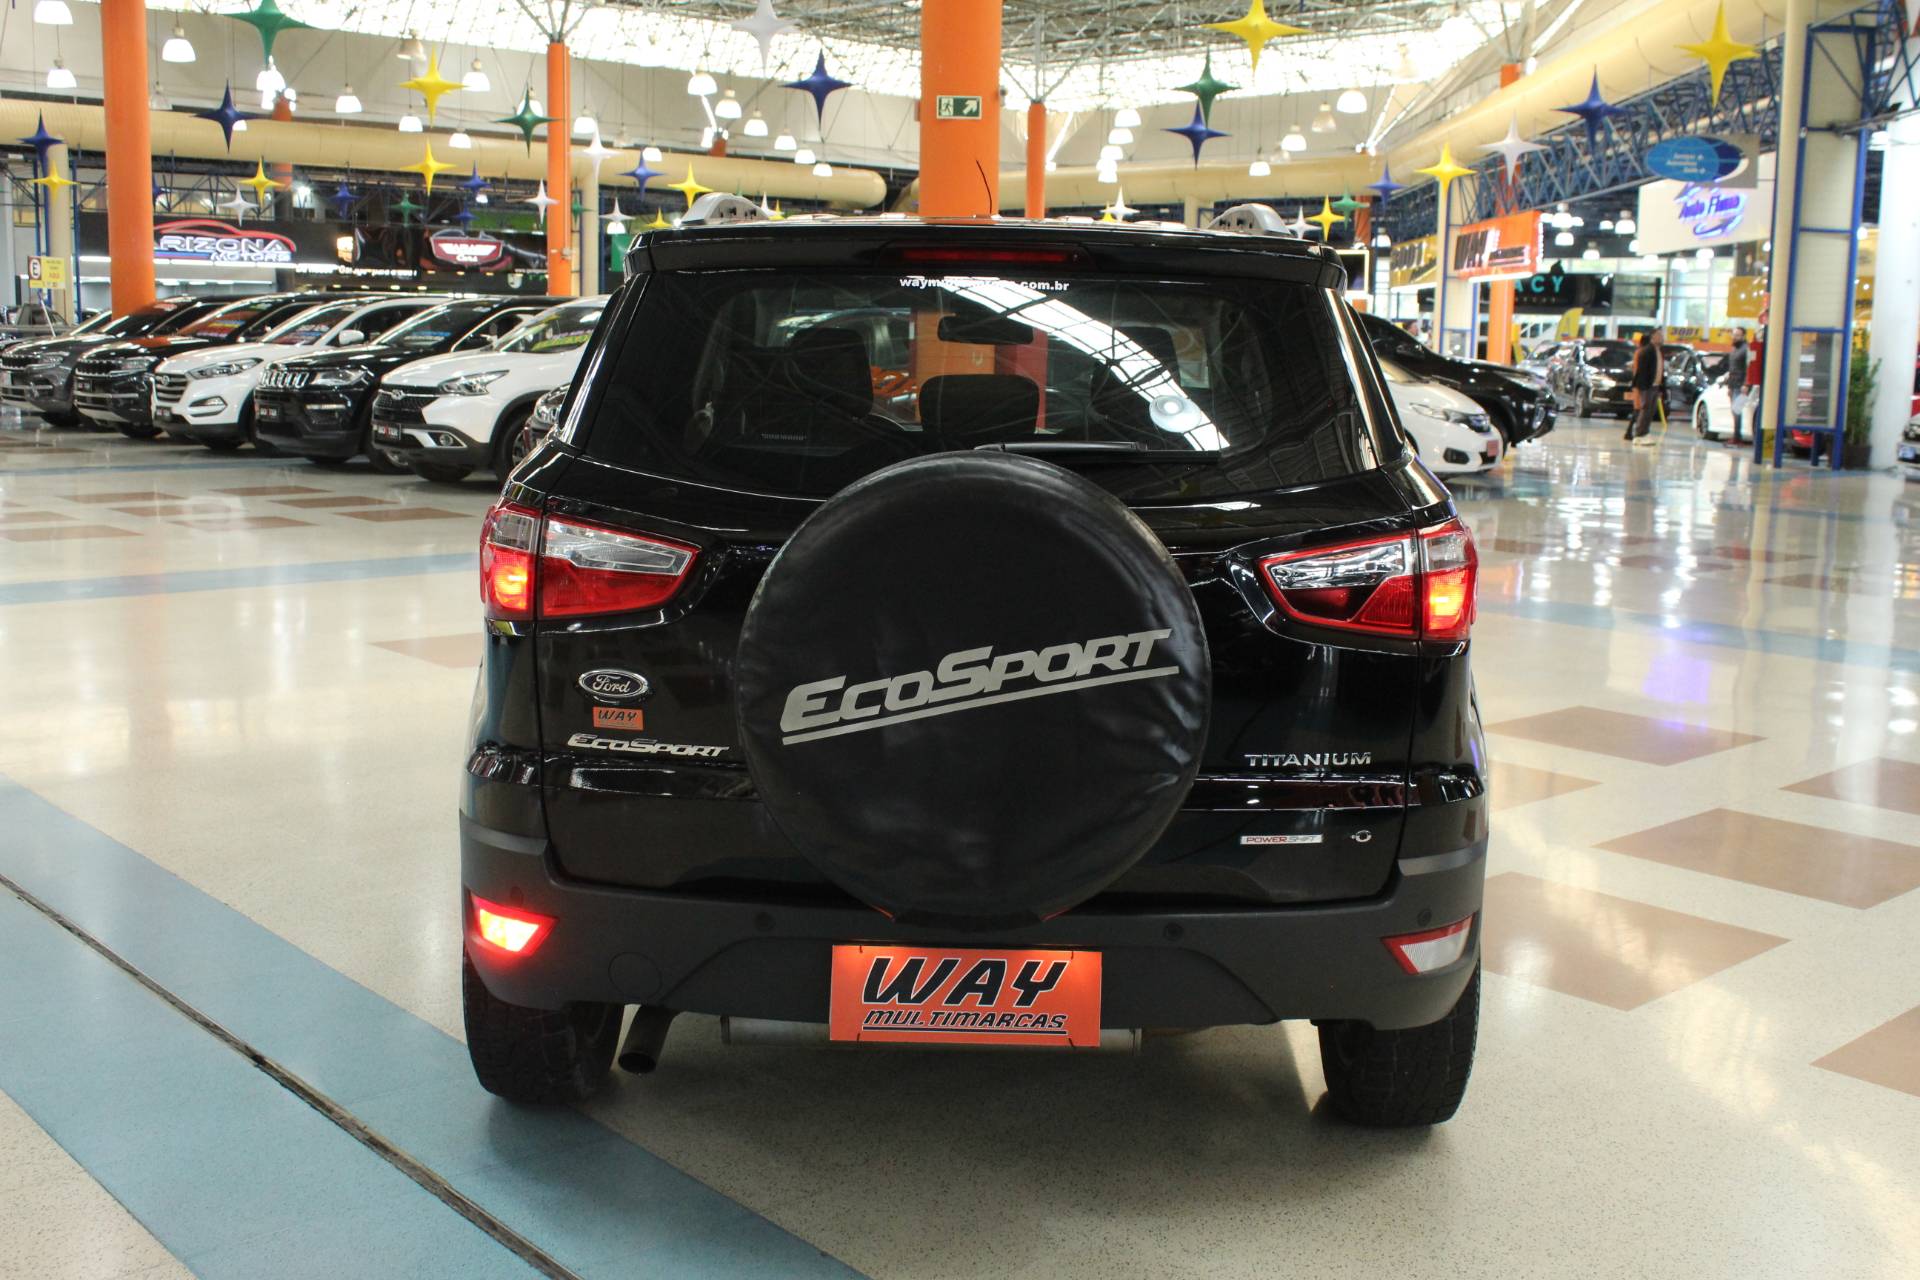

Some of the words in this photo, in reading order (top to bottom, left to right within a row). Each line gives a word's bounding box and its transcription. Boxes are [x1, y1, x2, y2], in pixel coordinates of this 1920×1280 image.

[154, 235, 289, 253] RIZONA
[211, 252, 290, 262] MOTORS
[592, 674, 631, 693] Ford
[598, 710, 637, 721] WAY
[1244, 752, 1371, 767] TITANIUM
[861, 955, 1071, 1007] WAY
[862, 1010, 1067, 1029] MULTIMARCAS
